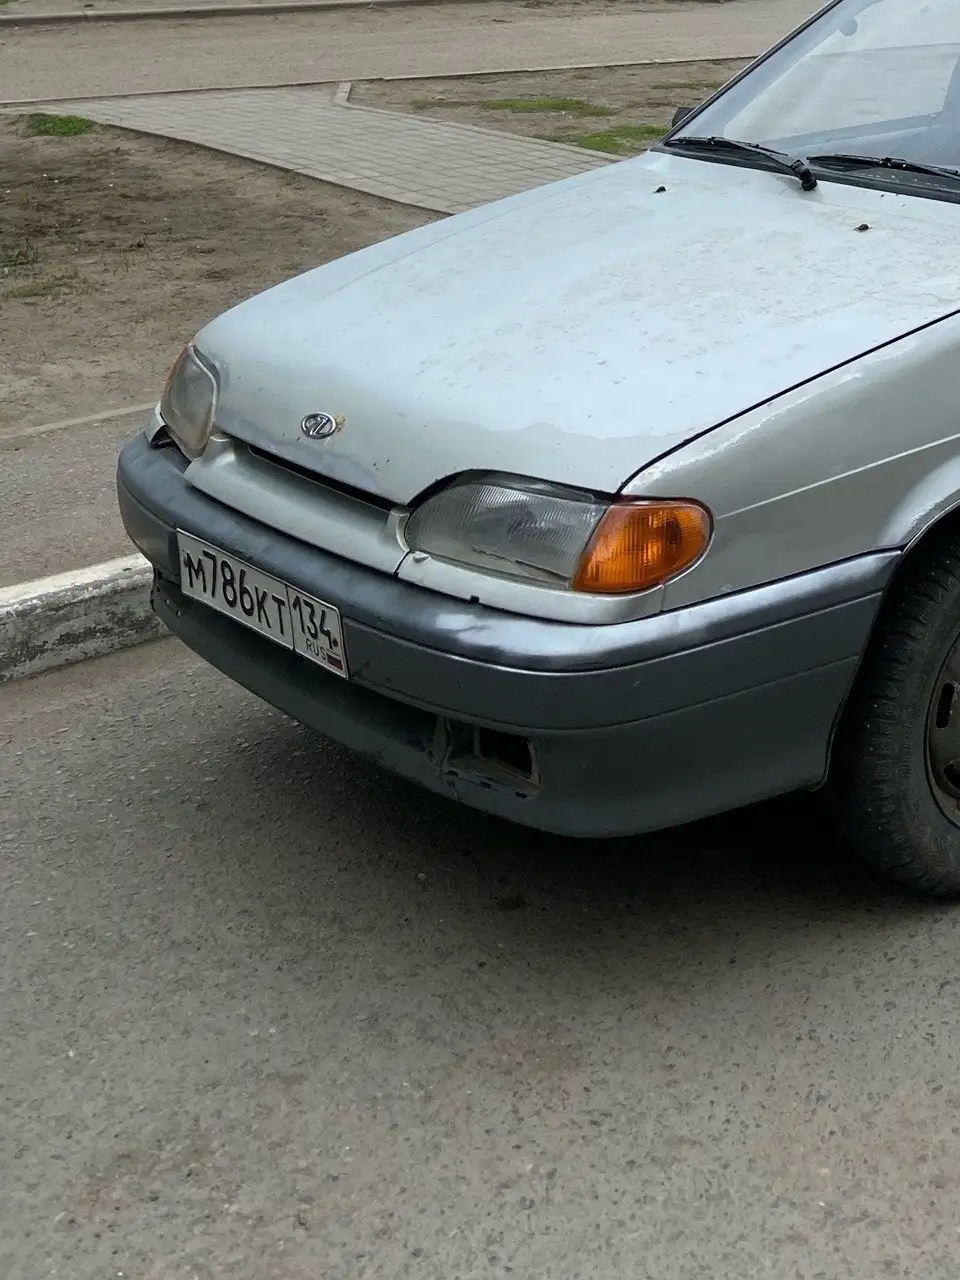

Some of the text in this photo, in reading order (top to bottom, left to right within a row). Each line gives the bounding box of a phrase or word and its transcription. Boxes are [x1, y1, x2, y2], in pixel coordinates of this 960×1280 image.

[184, 548, 286, 636] М786КТ
[292, 595, 334, 651] 134
[305, 638, 327, 661] RUS
